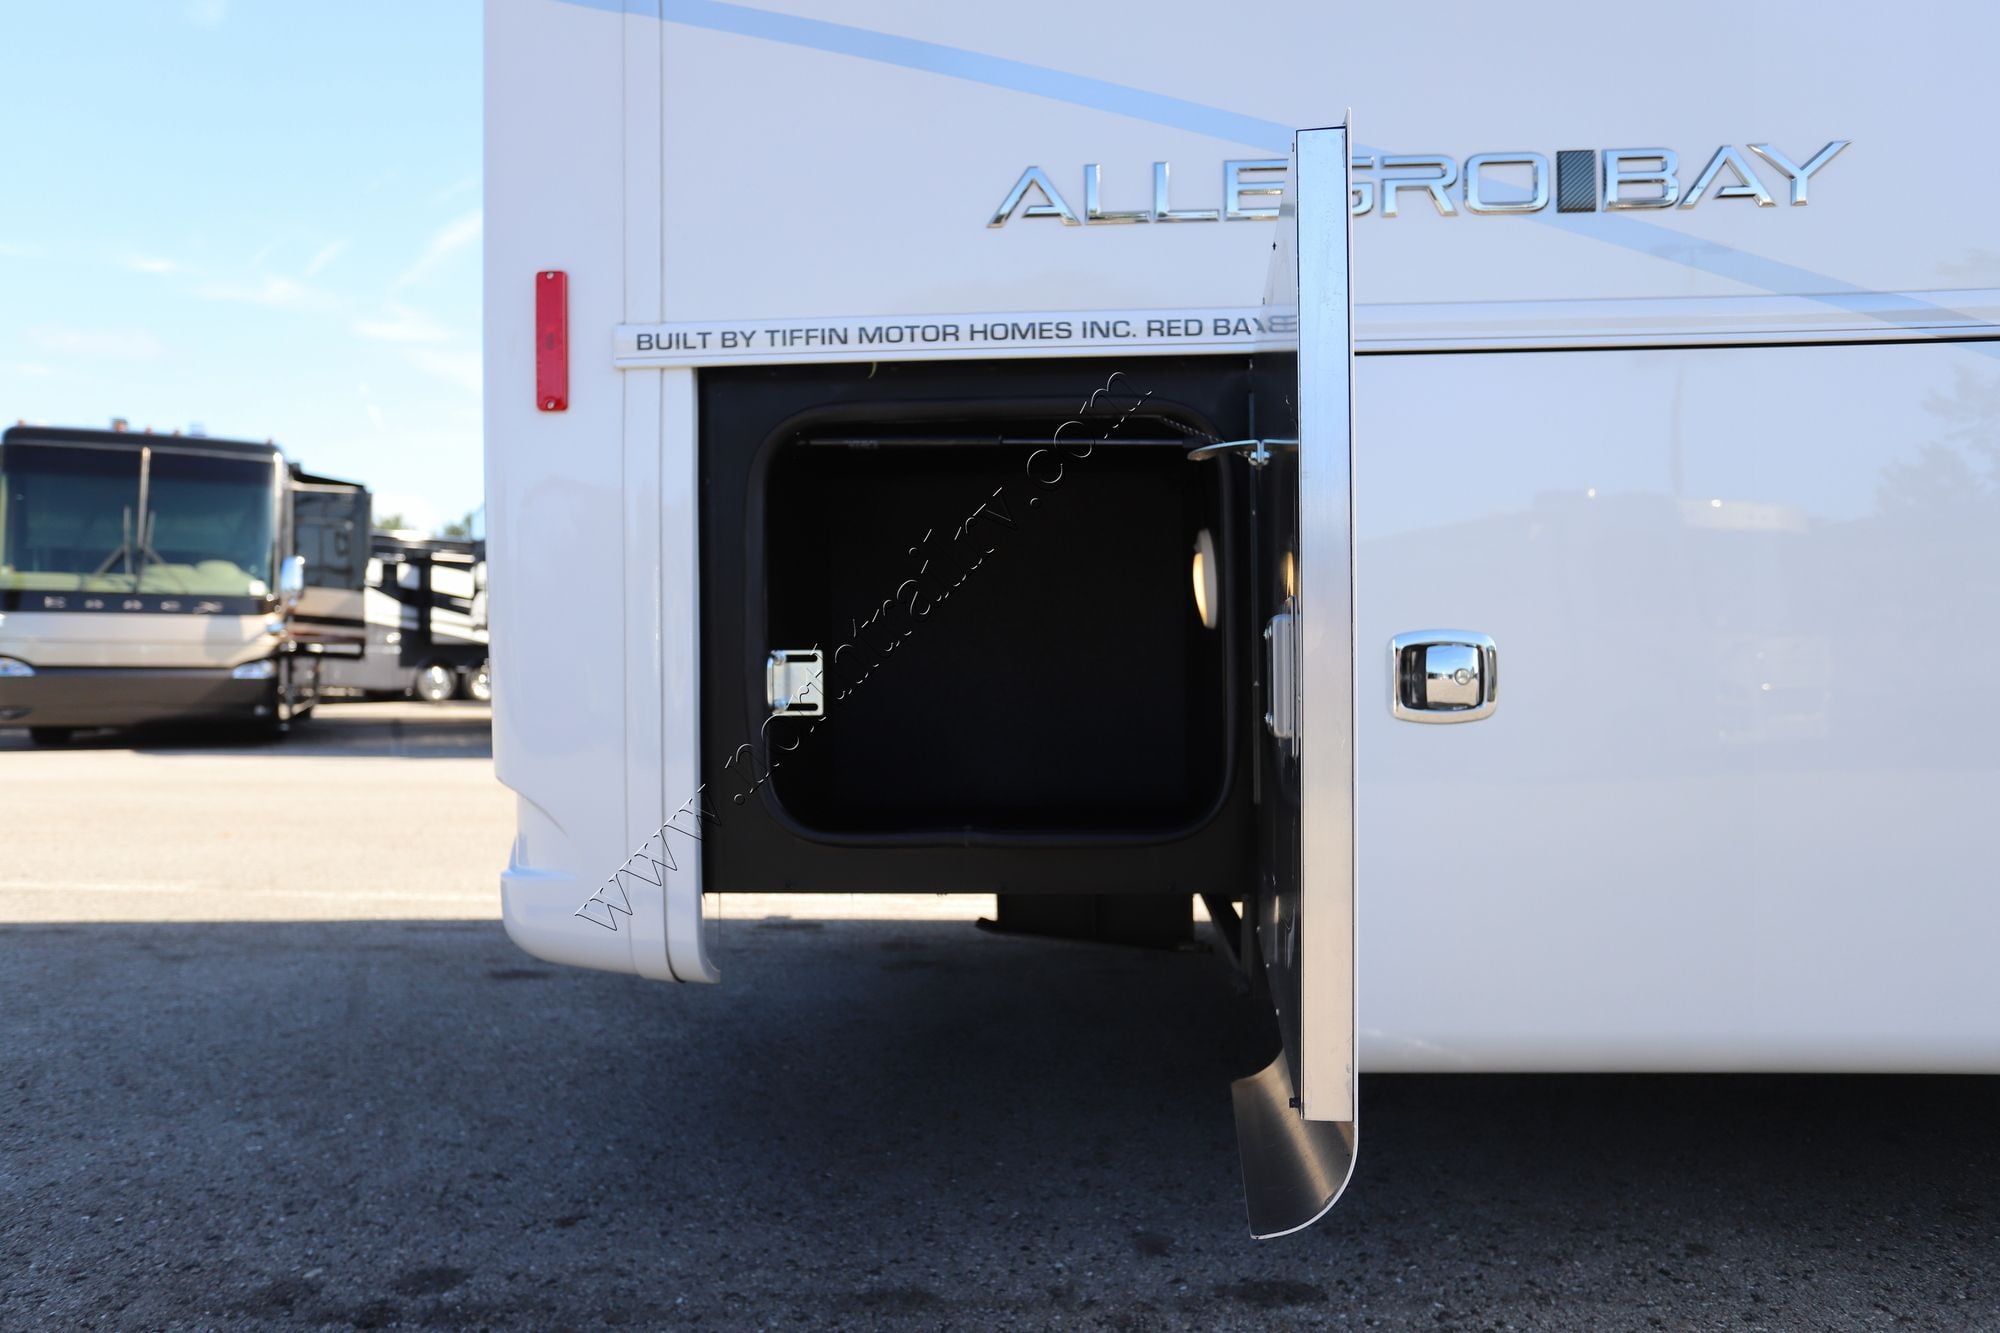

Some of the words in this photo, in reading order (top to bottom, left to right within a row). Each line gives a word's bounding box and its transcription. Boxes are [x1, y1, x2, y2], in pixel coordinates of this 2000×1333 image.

[1604, 139, 1850, 214] BAY
[636, 331, 712, 351] BUILT
[721, 330, 757, 348] BY
[765, 327, 848, 347] TIFFIN
[858, 324, 960, 344] MOTOR
[970, 321, 1072, 342] HOMES
[1082, 320, 1136, 339] INC.
[1147, 318, 1203, 338] RED
